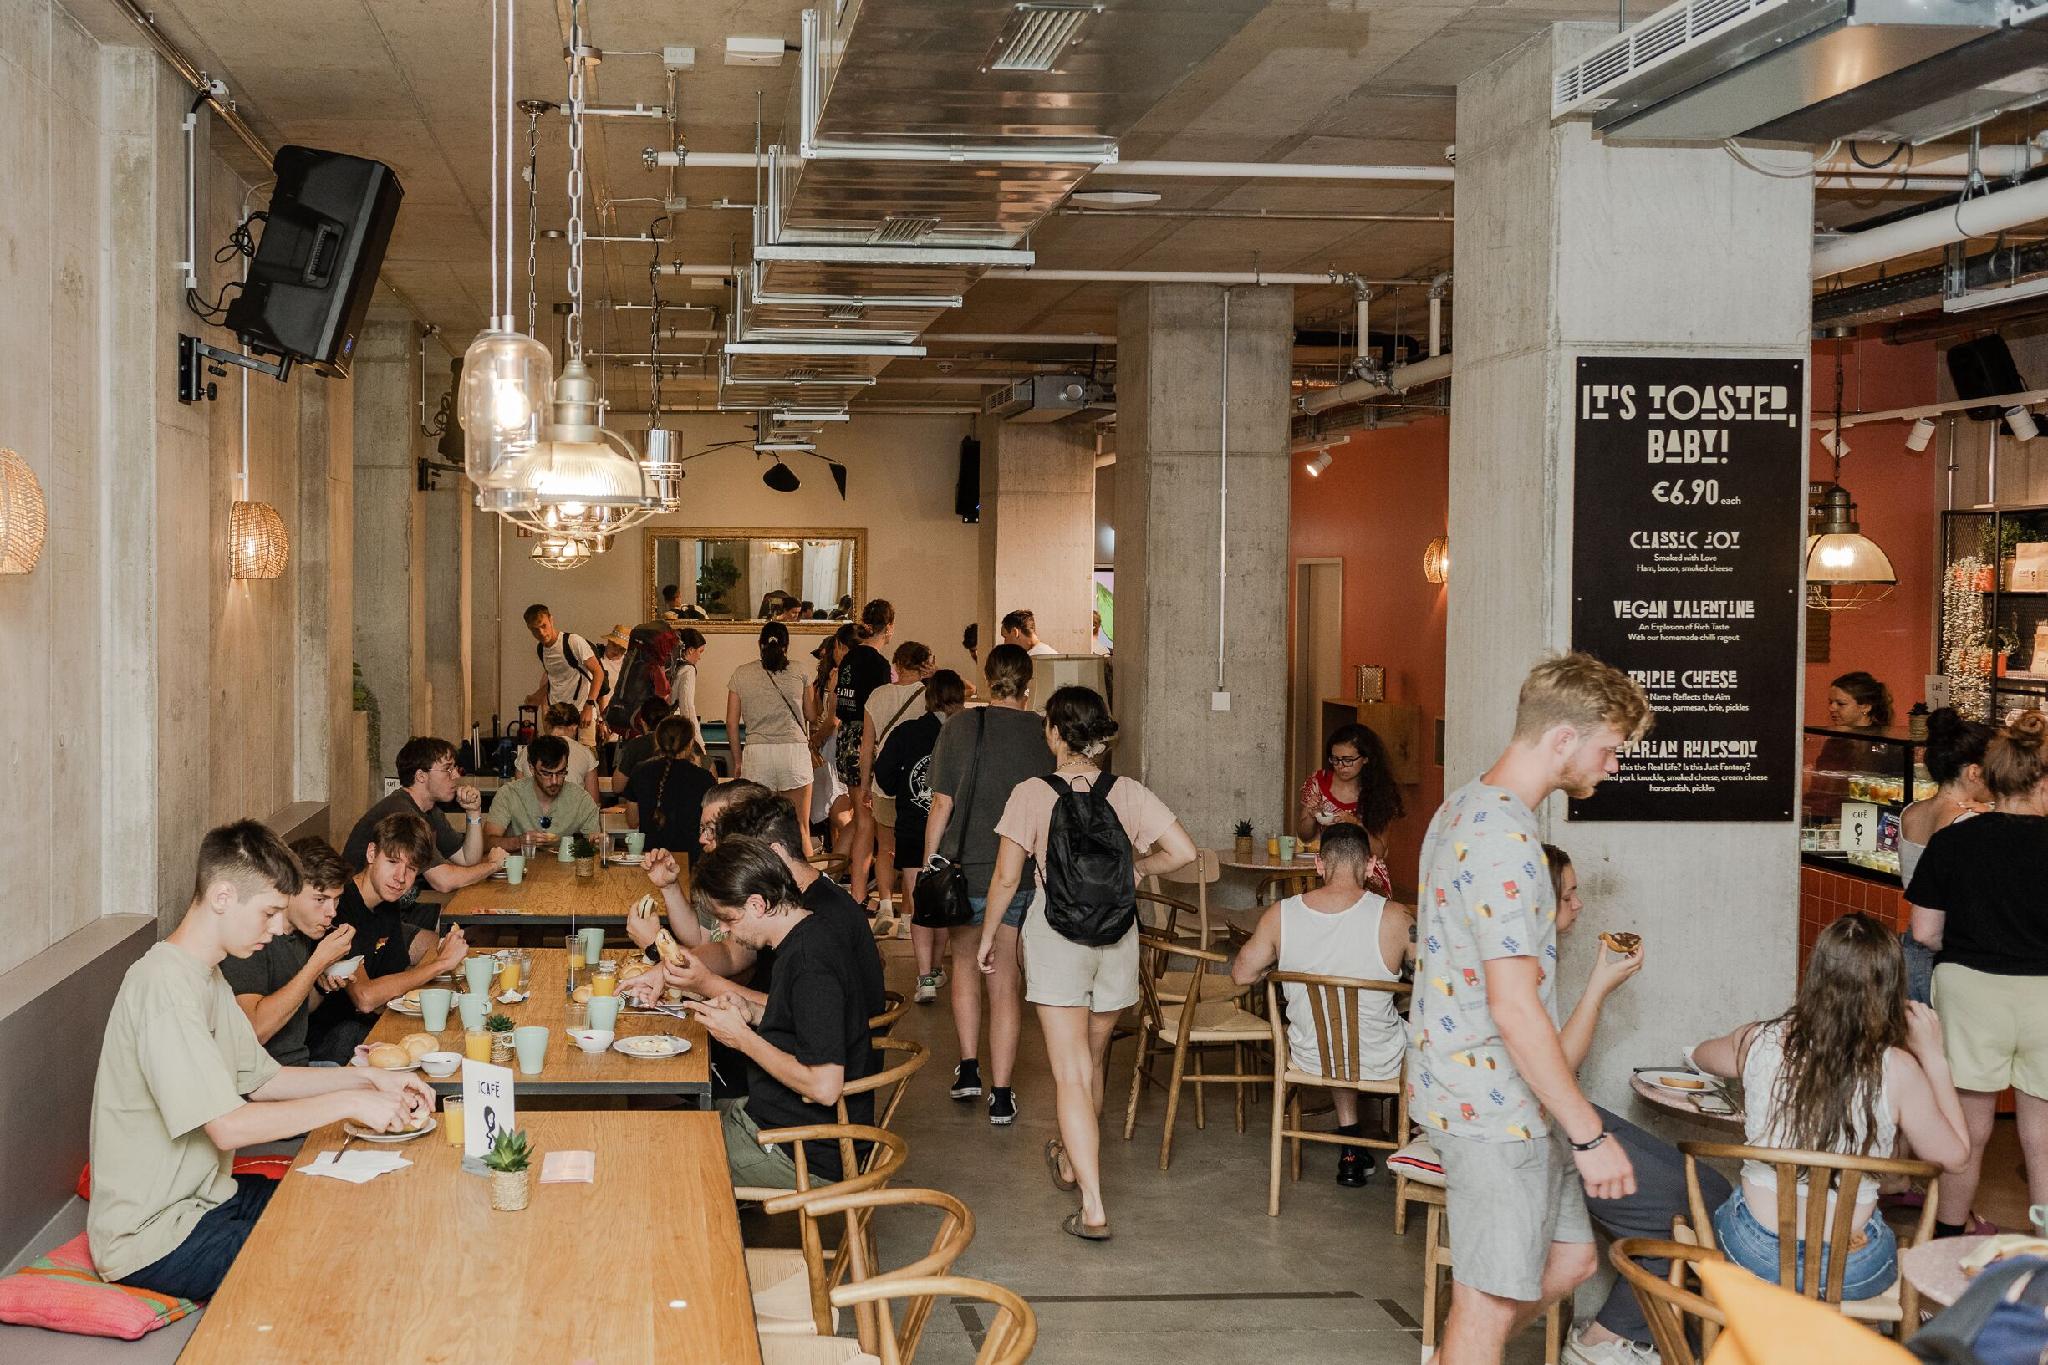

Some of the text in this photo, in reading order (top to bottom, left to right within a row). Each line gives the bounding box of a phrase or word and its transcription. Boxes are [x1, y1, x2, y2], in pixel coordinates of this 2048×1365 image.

[1583, 385, 1797, 428] IT'S TOASTED,
[1648, 430, 1729, 464] BABY!
[1652, 479, 1741, 505] €6.90 each
[1629, 531, 1741, 549] CLASSIC JOY
[1653, 553, 1717, 562] Smoked with Love
[1636, 564, 1733, 574] Ham, bacon, smoked cheese
[1613, 600, 1755, 619] VEGAN VALENTINE
[1638, 622, 1730, 633] An Explosion of Rich Taste
[1628, 633, 1646, 641] With
[1660, 633, 1699, 641] homemade
[1699, 633, 1716, 641] chilli
[1716, 634, 1740, 644] ragout
[1628, 670, 1738, 689] TRIPLE CHEESE
[1649, 692, 1671, 701] Name
[1672, 692, 1701, 701] Reflects
[1702, 693, 1714, 701] the
[1715, 693, 1731, 701] Aim
[1648, 703, 1750, 714] heese, parmesan, brie, pickles
[1683, 741, 1758, 759] RHAPSODY
[1620, 763, 1750, 773] this the Real Life? Is this Just Fantasy?
[1620, 773, 1636, 783] pork
[1637, 773, 1665, 783] knuckle,
[1666, 773, 1693, 782] smoked
[1694, 773, 1720, 783] cheese,
[1744, 773, 1768, 782] cheese
[1649, 784, 1716, 794] horseradish, pickles
